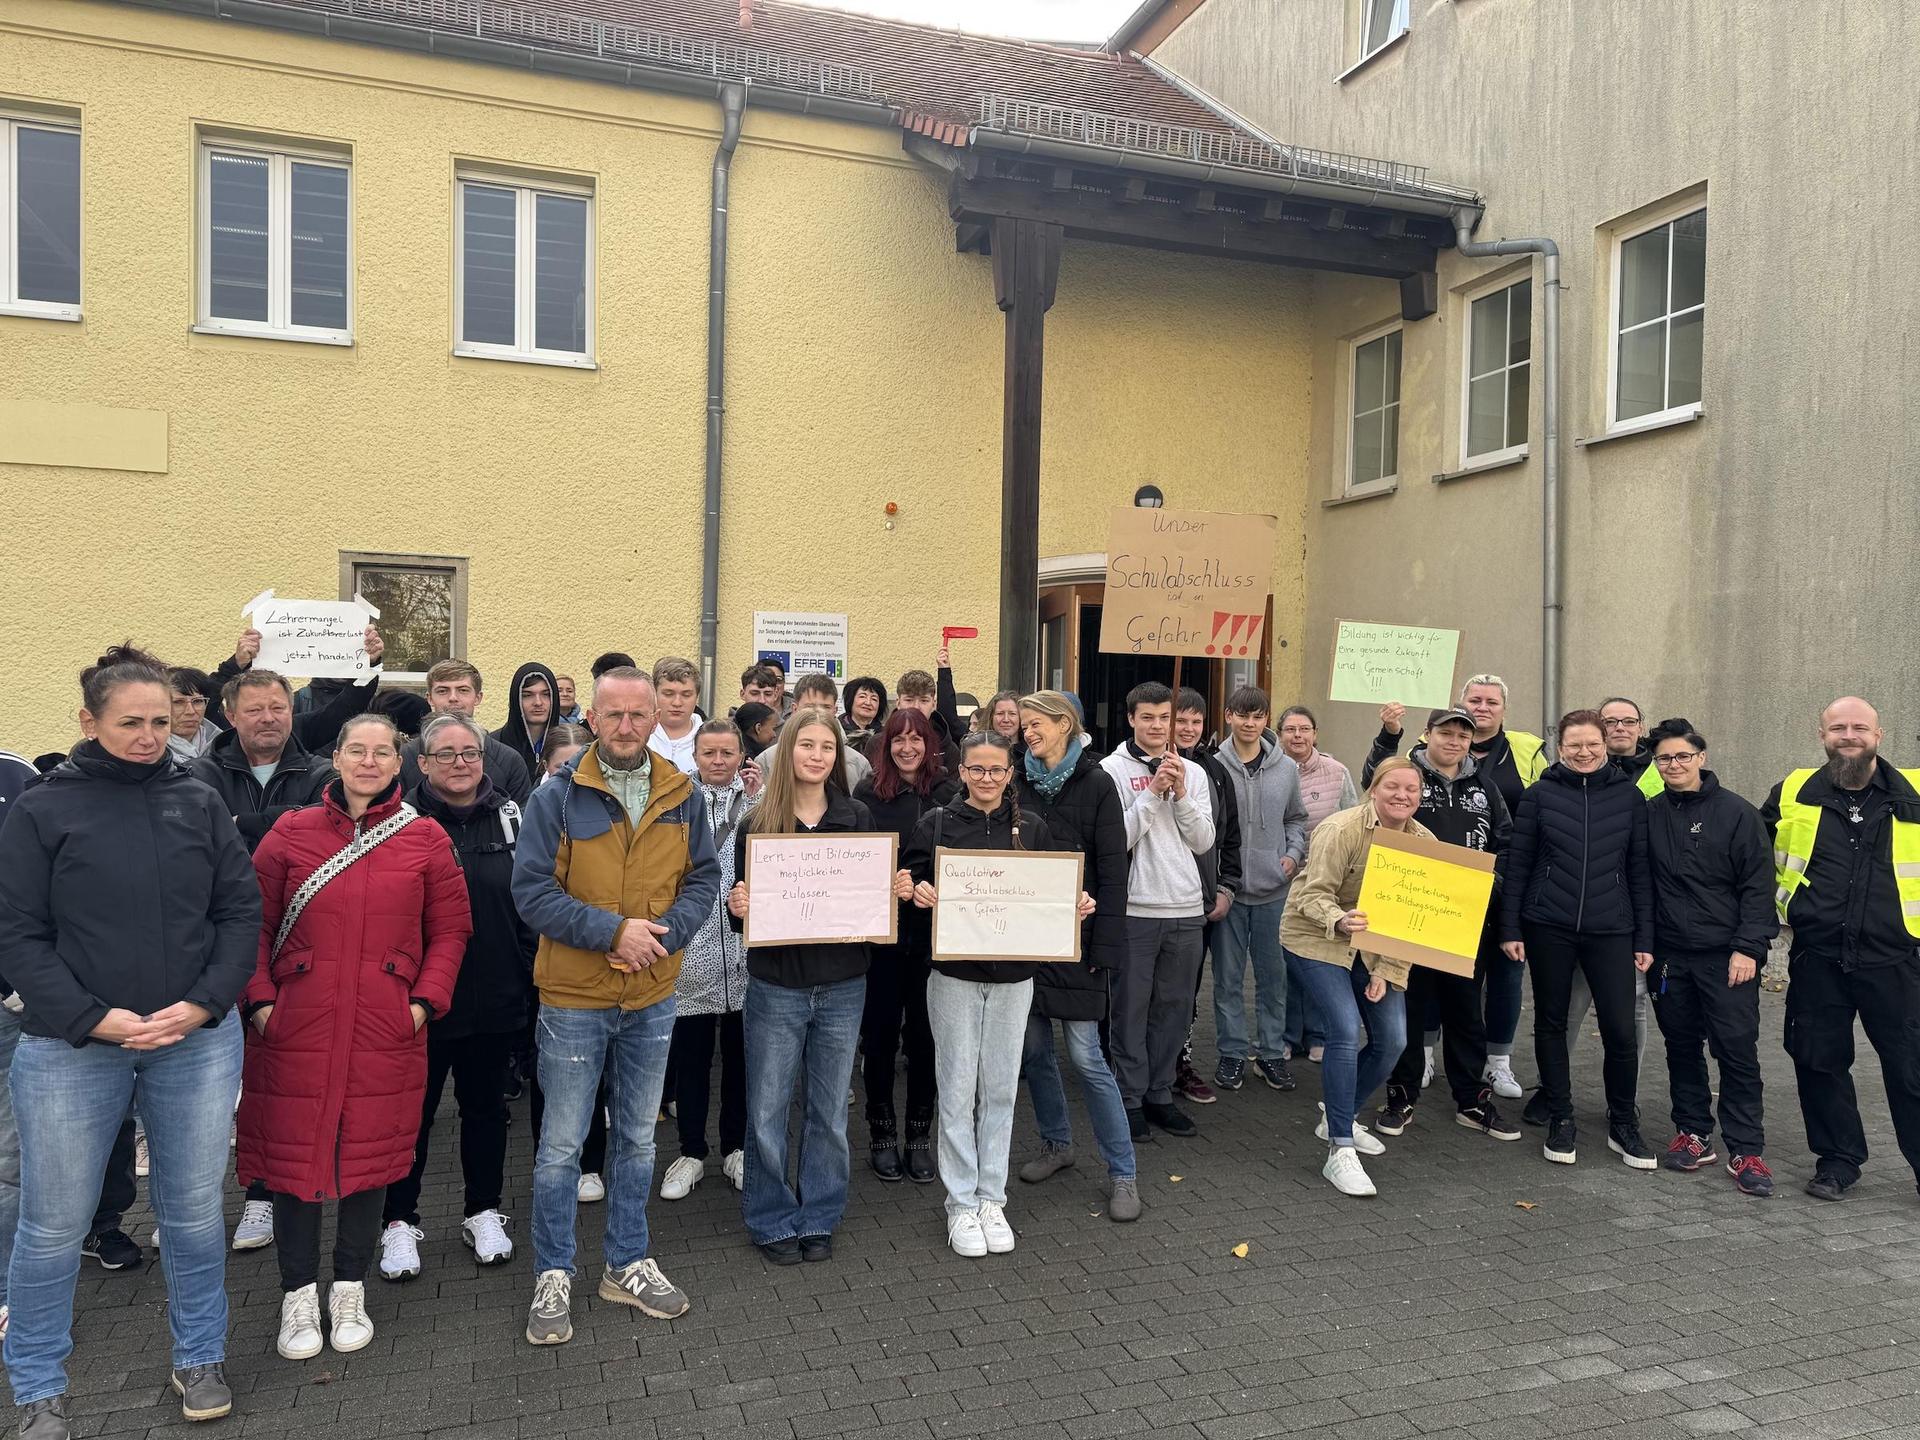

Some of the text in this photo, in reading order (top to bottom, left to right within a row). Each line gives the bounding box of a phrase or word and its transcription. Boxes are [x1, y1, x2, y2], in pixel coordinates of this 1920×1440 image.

[1153, 513, 1208, 533] Unser
[1110, 554, 1255, 590] Schulabschluss
[1168, 591, 1182, 600] ist
[265, 610, 344, 626] Lehrermangel
[1126, 610, 1264, 656] Gefahr !!!
[1340, 626, 1376, 642] Bildung
[1382, 630, 1394, 638] ist
[1398, 630, 1424, 645] wichtig
[282, 650, 312, 664] jetzt
[1360, 646, 1390, 658] gesunde
[1396, 646, 1430, 659] Zukunft
[1338, 662, 1356, 670] und
[1370, 676, 1383, 692] !!!
[801, 850, 820, 860] und
[1374, 852, 1428, 878] Dringende
[964, 881, 1036, 896] Schulabschluss
[800, 902, 815, 921] !!!
[958, 902, 1008, 918] in Gefahr
[1375, 890, 1462, 918] des Bildungssystems
[994, 919, 1007, 935] !!!
[1408, 911, 1426, 932] !!!
[624, 1276, 648, 1296] N
